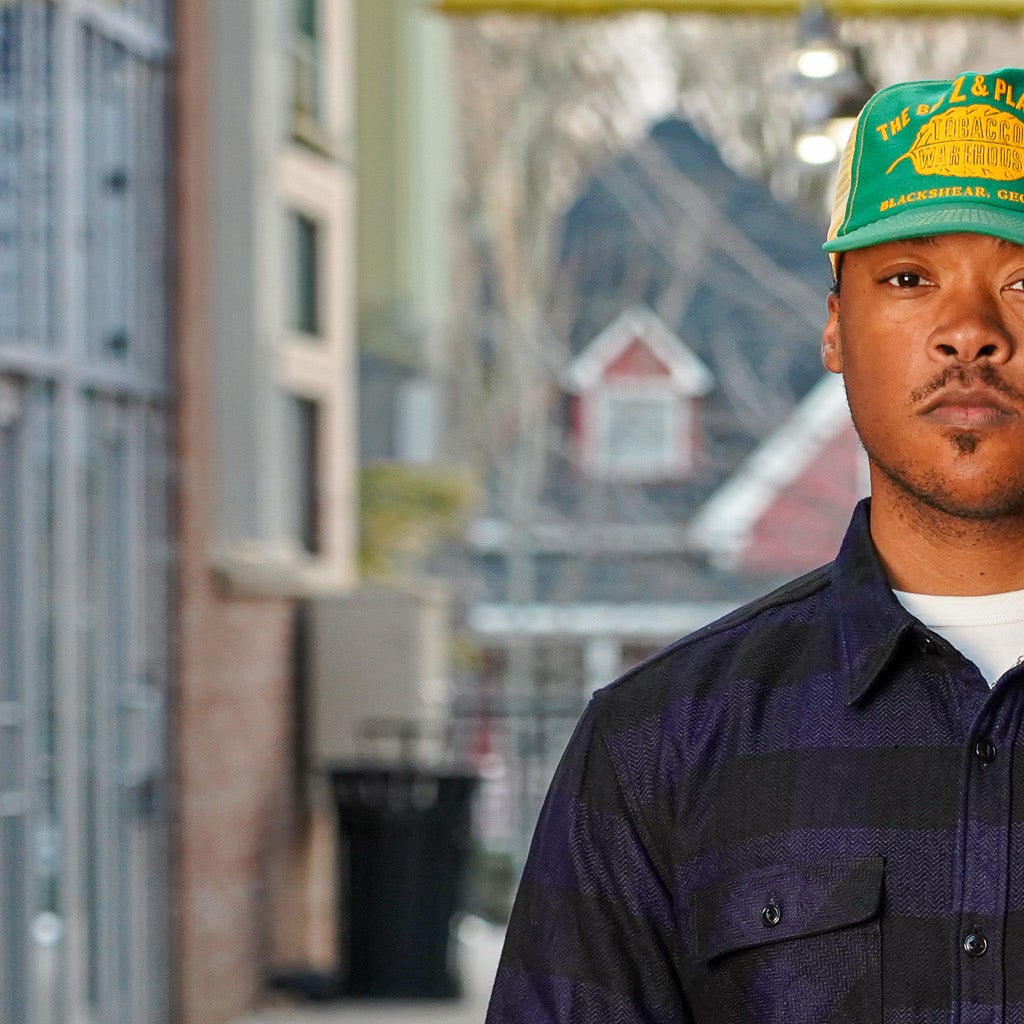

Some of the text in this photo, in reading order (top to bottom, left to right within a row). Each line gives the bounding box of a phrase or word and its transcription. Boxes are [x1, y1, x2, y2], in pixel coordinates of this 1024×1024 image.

[876, 106, 910, 142] THE
[971, 74, 989, 97] &
[931, 116, 1024, 146] TOBACCO
[879, 186, 991, 213] BLACKSHEAR,
